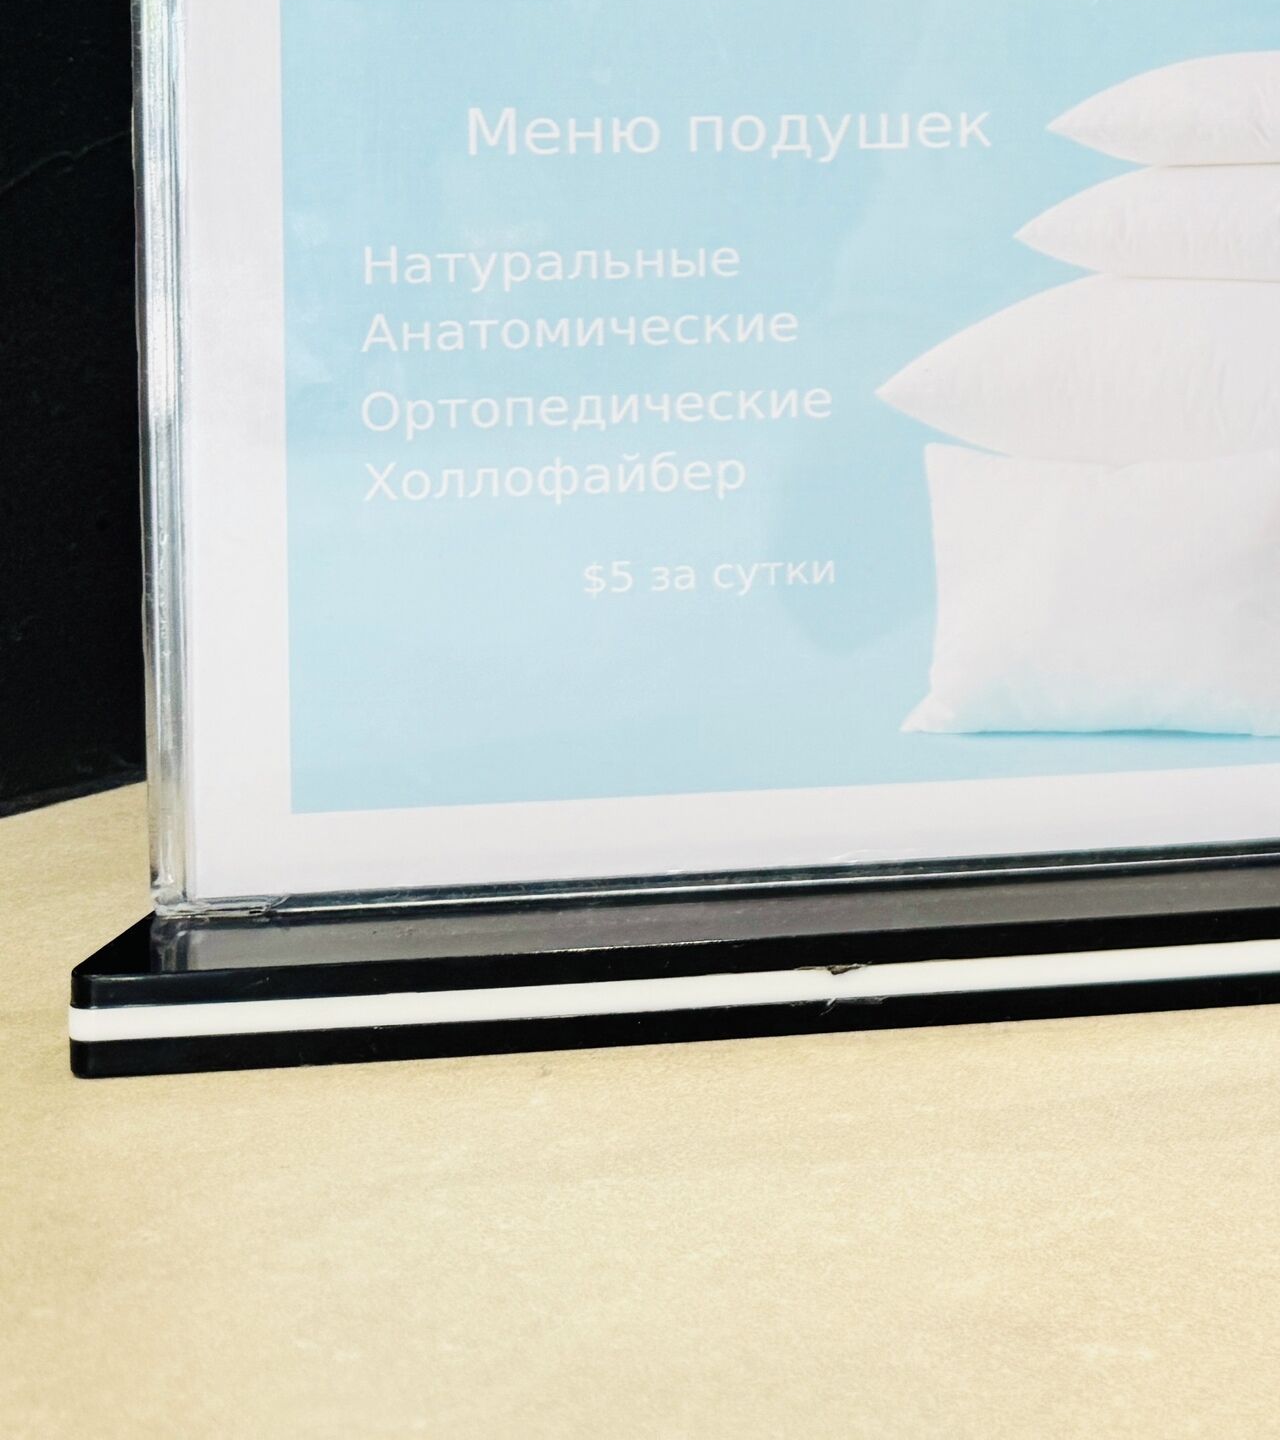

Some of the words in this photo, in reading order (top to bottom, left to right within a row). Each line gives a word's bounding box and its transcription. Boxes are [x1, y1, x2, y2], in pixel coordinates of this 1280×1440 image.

[468, 107, 660, 156] Меню
[689, 108, 991, 163] подушек
[364, 240, 740, 293] Натуральные
[362, 313, 798, 352] Анатомические
[362, 388, 832, 440] Ортопедические
[365, 452, 746, 504] Холлофайбер
[584, 561, 633, 596] $5
[652, 566, 695, 591] за
[714, 560, 834, 595] сутки
